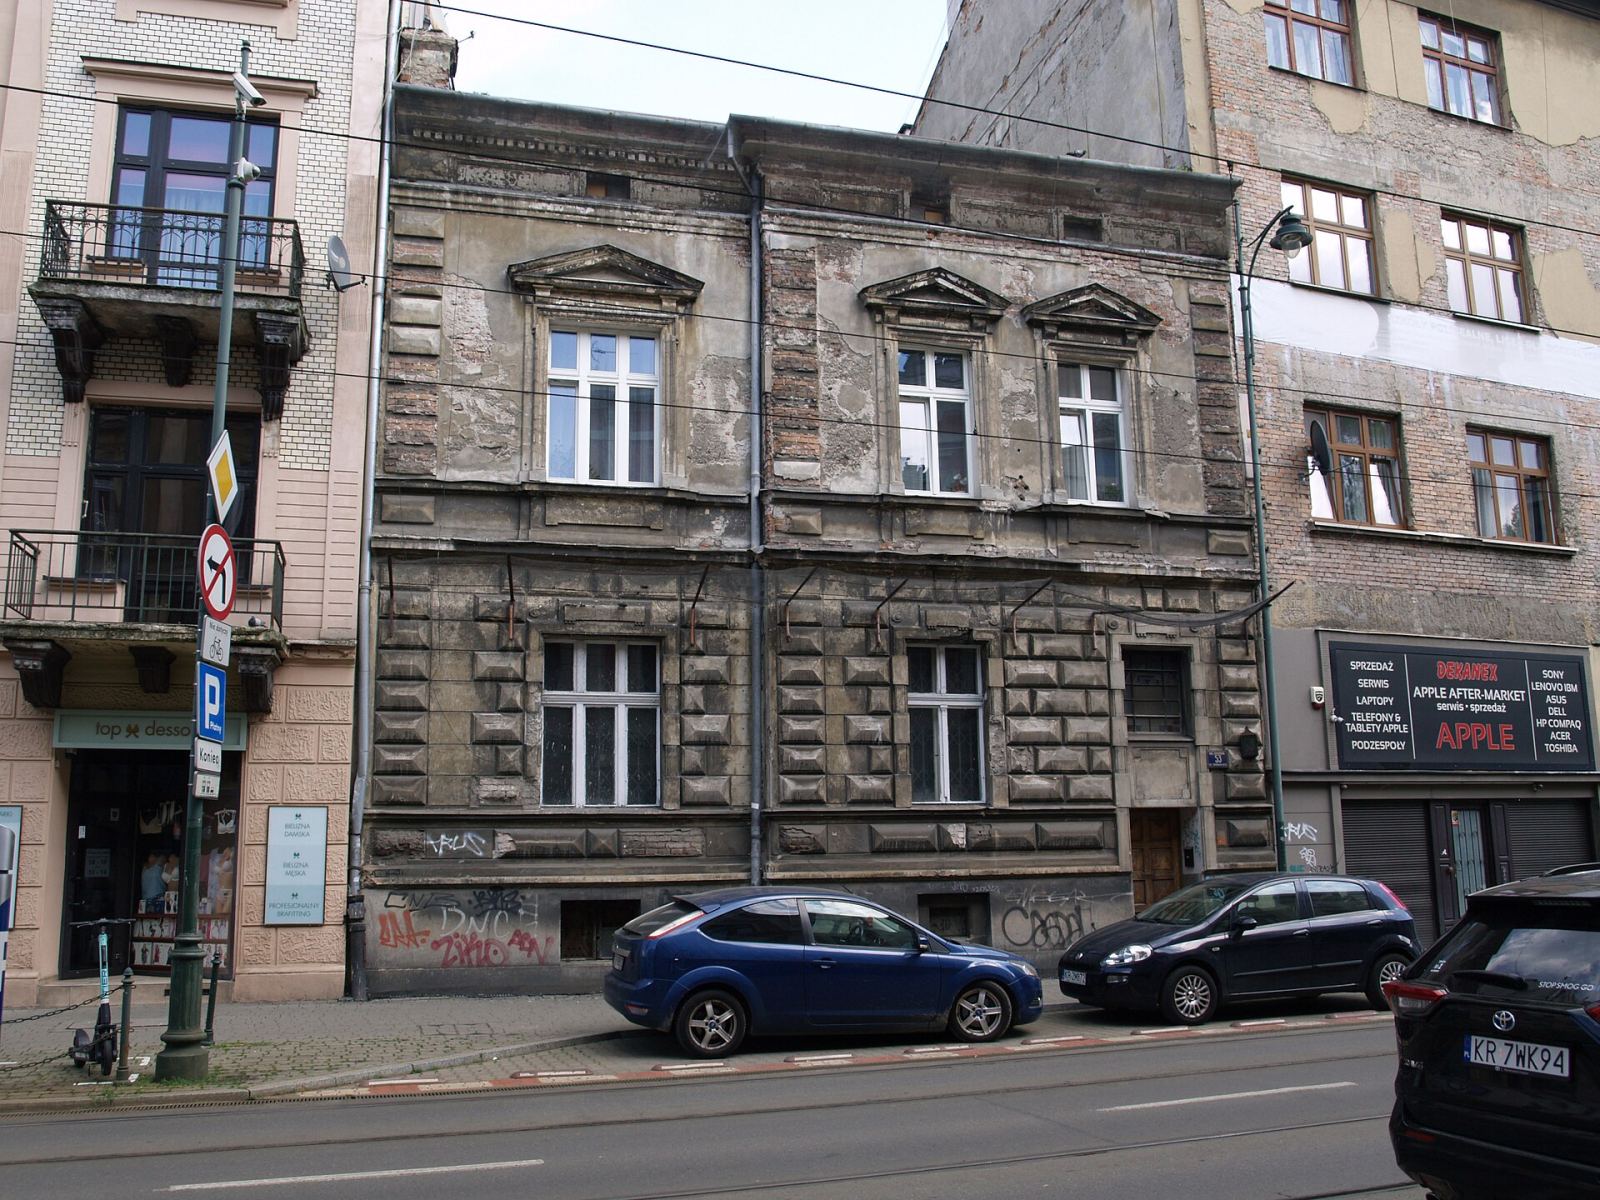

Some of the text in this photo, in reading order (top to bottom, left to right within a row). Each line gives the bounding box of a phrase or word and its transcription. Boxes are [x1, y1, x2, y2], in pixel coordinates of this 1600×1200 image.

[1350, 661, 1394, 671] SPRZEDAŻ
[1437, 660, 1498, 681] DEKANEX
[1542, 669, 1564, 679] SONY
[1358, 678, 1389, 688] SERWIS
[1531, 681, 1578, 693] LENOVO IBM
[1413, 686, 1525, 701] APPLE AFTER-MARKET
[205, 672, 220, 729] P
[1356, 696, 1394, 706] LAPTOPY
[1546, 695, 1567, 704] ASUS
[1436, 701, 1506, 714] serwis sprzedaż
[1548, 707, 1567, 716] DELL
[1351, 712, 1401, 722] TELEFONY &
[1345, 723, 1408, 733] TABLETY APPLE
[1536, 719, 1581, 730] HP COMPAQ
[96, 721, 122, 740] top
[1435, 722, 1515, 750] APPLE
[1550, 731, 1571, 741] ACER
[1352, 740, 1406, 750] PODZESPOŁY
[1544, 743, 1578, 753] TOSHIBA
[1474, 1038, 1564, 1074] KR 7WK94
